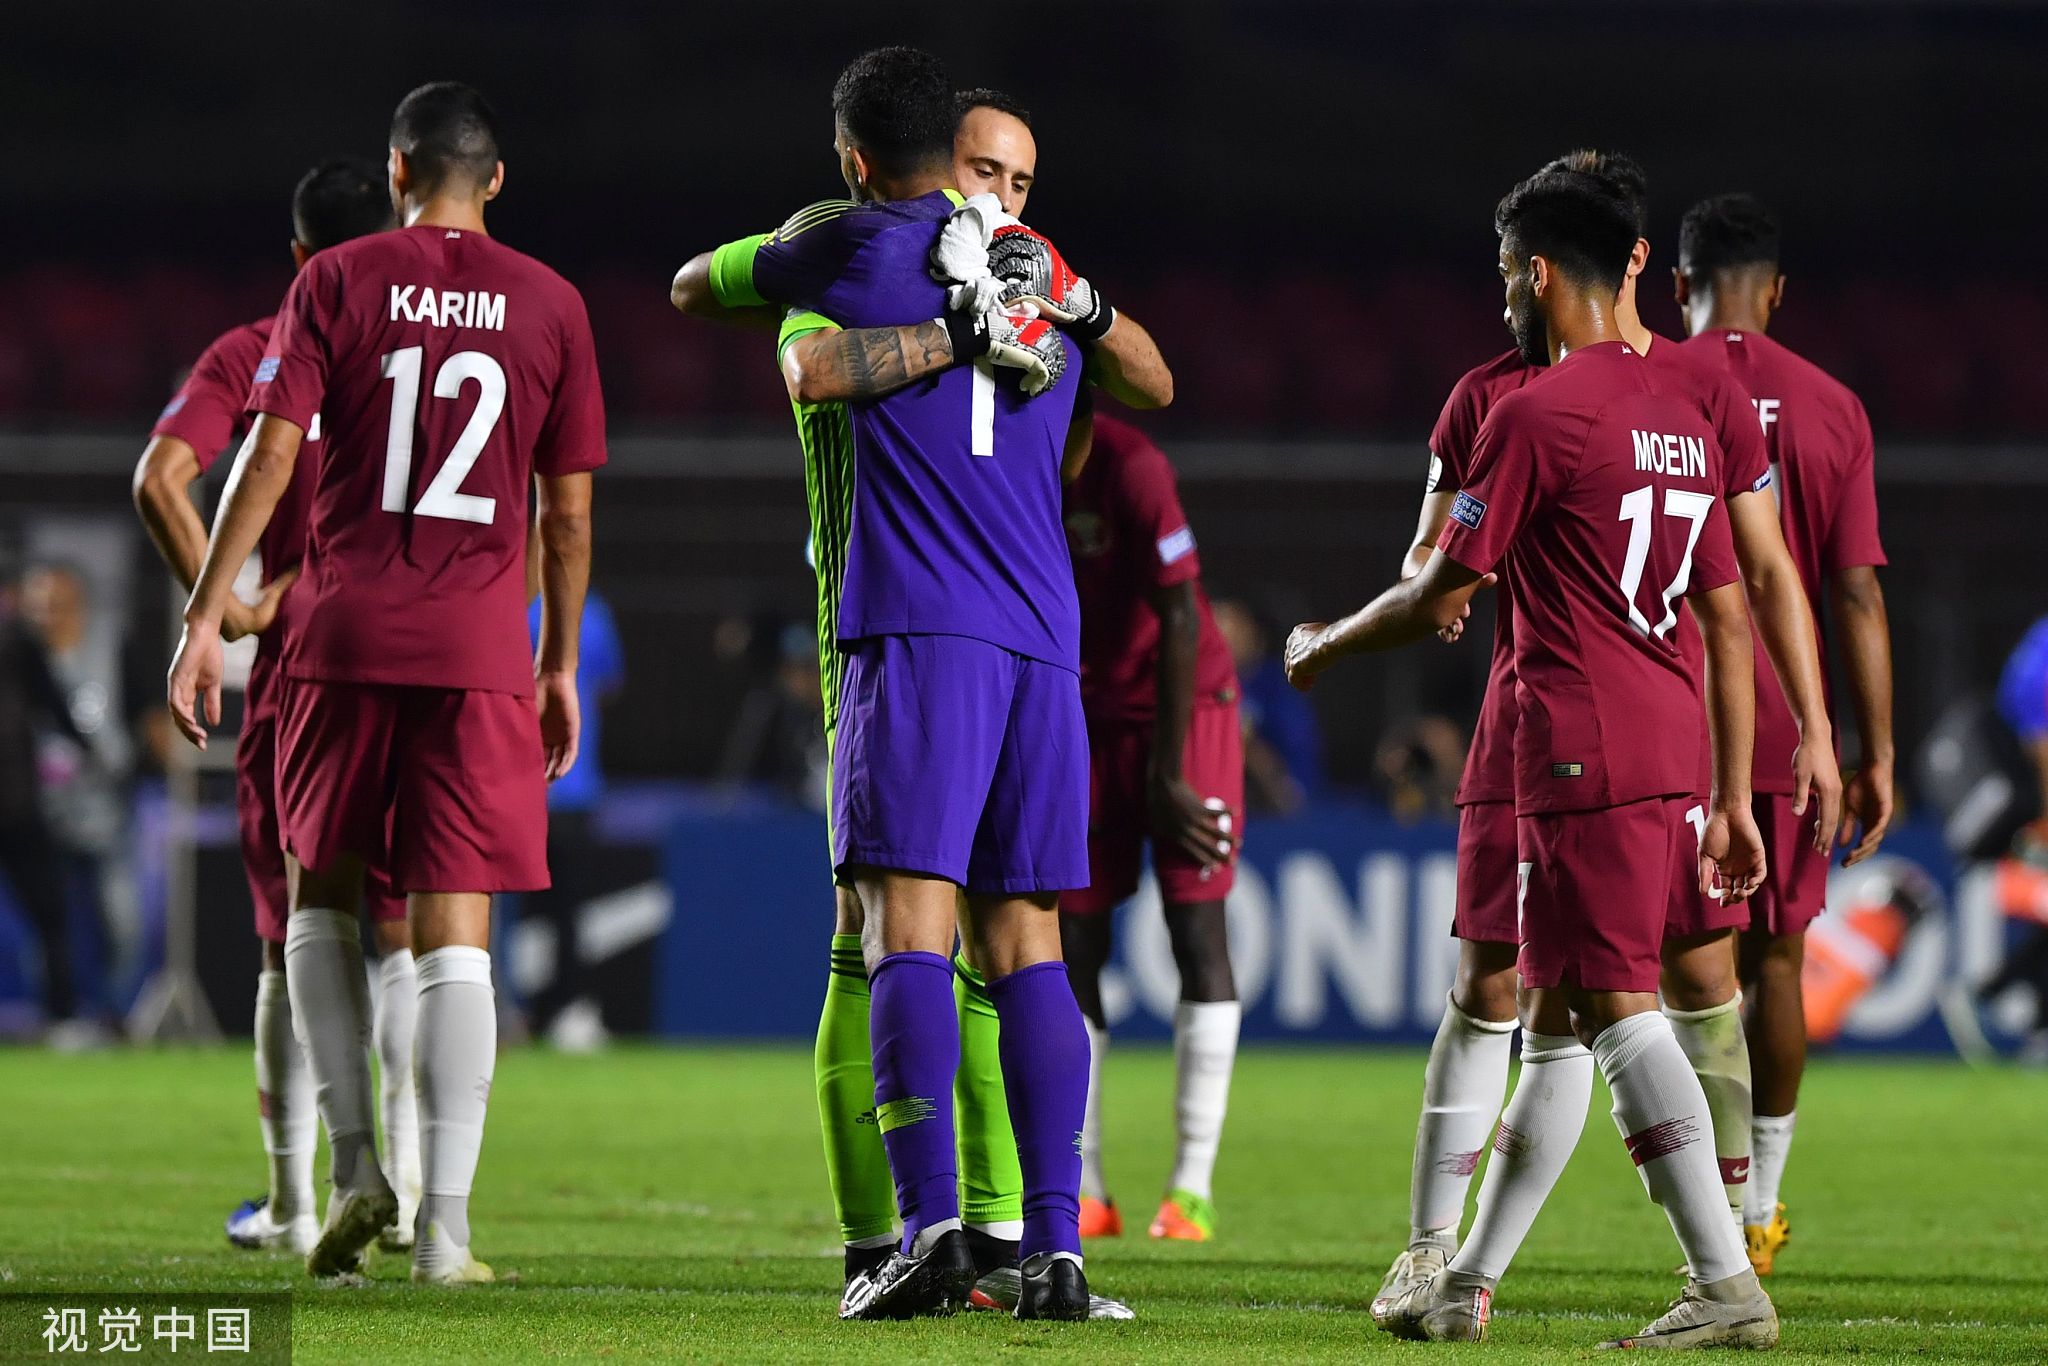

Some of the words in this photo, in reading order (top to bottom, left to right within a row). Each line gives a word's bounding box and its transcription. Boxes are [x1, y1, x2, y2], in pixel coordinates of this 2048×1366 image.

[390, 284, 507, 331] KARIM
[380, 345, 507, 525] 12
[1751, 398, 1780, 437] F
[1631, 429, 1706, 478] MOEIN
[1618, 484, 1716, 641] 17
